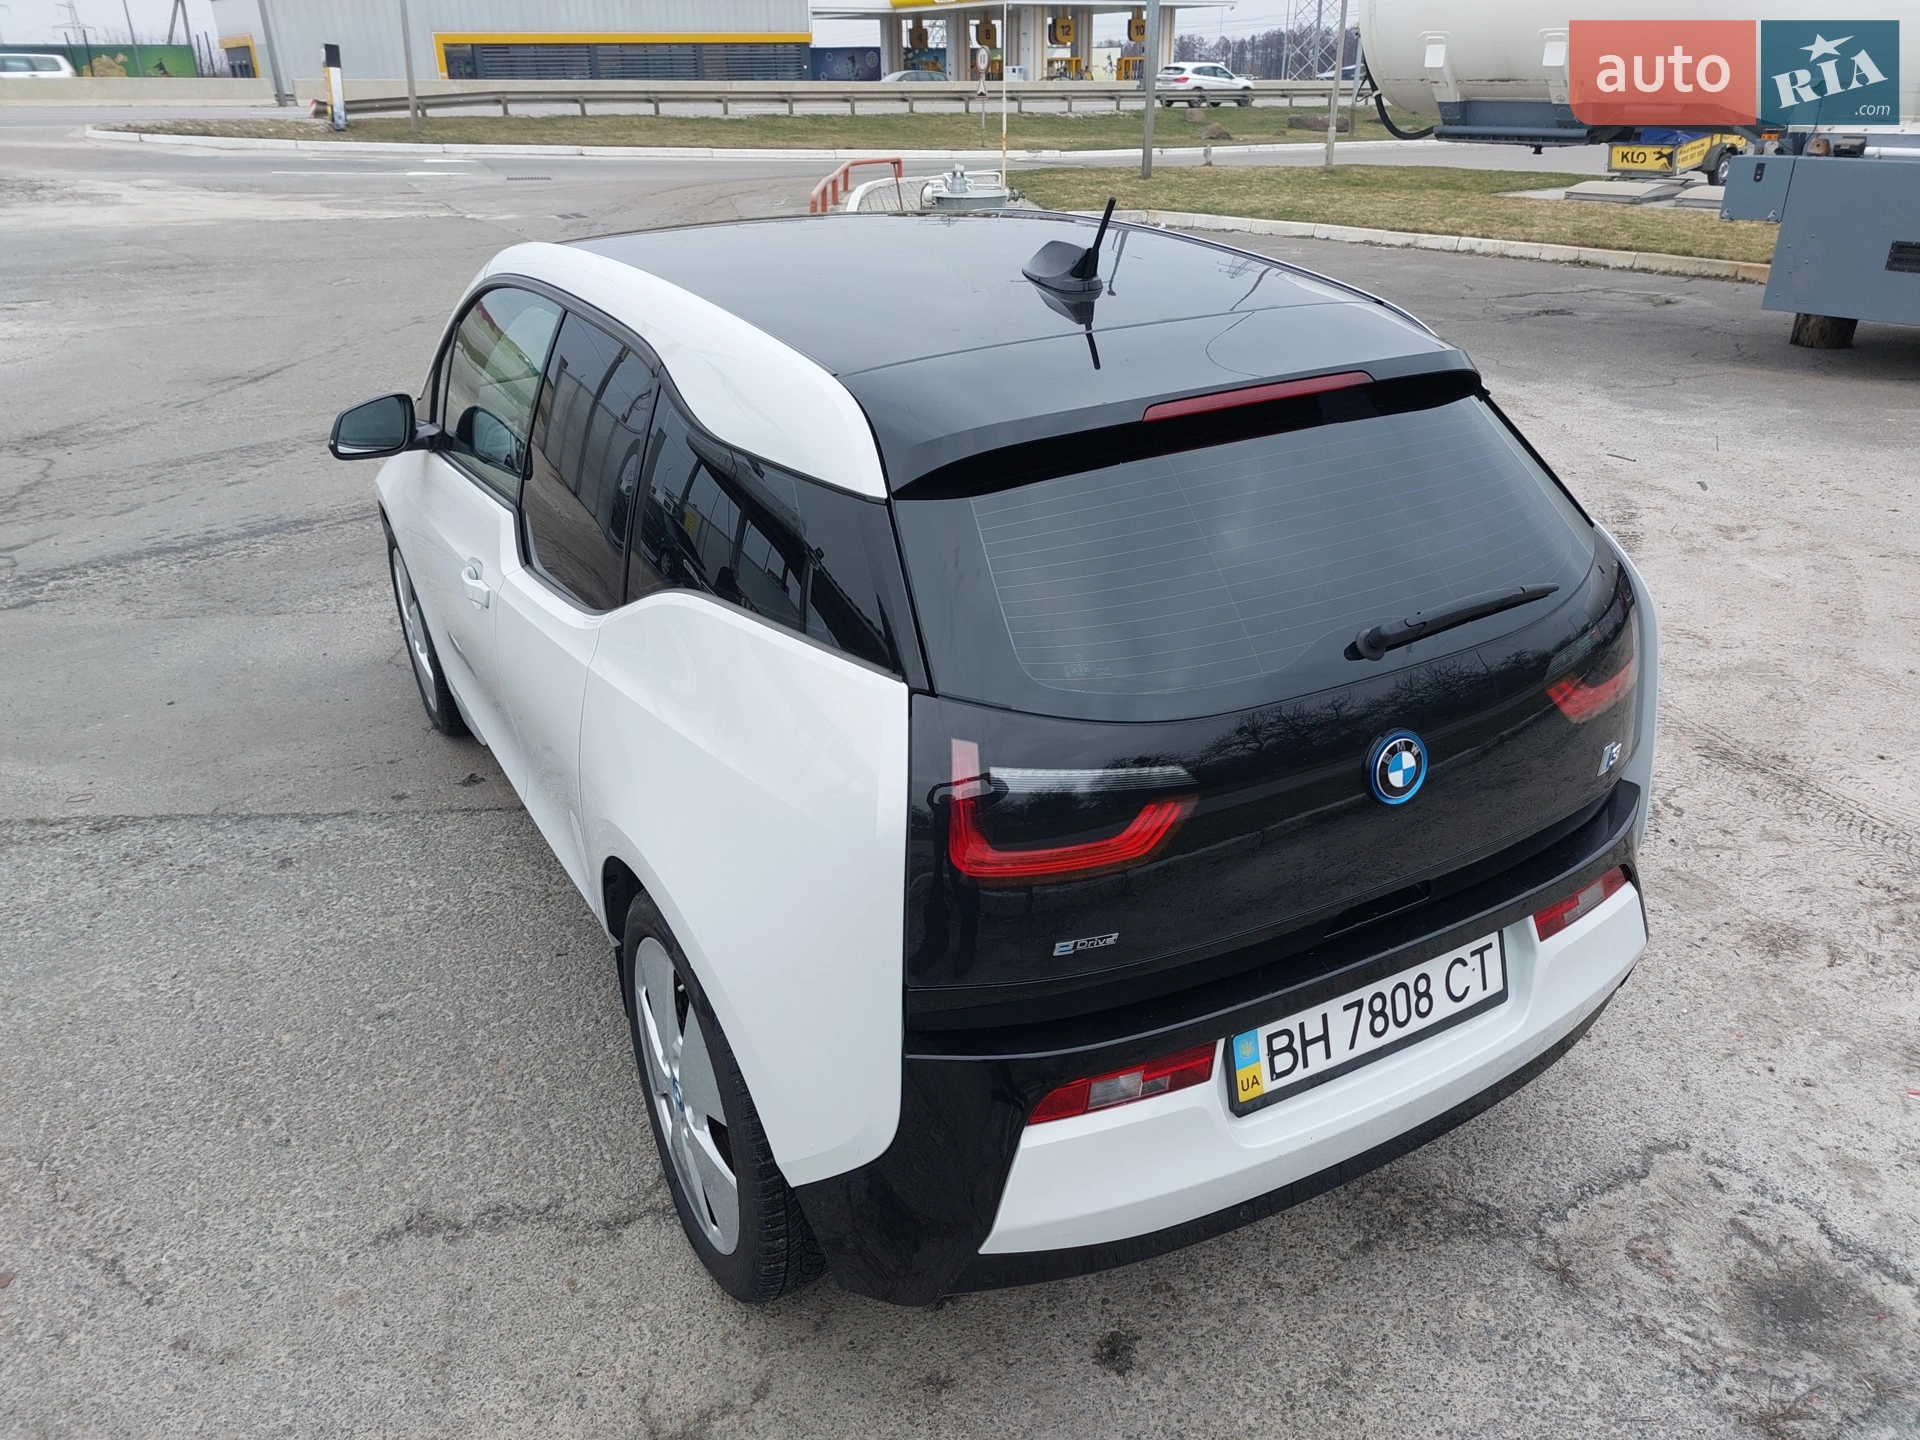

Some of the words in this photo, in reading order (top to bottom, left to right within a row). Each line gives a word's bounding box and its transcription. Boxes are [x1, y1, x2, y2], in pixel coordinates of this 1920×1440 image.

[1061, 24, 1072, 36] 12
[1135, 25, 1146, 36] 10
[1621, 151, 1647, 164] KLO
[1382, 741, 1421, 765] BMW
[1266, 1012, 1332, 1082] BH
[1342, 972, 1434, 1051] 7808
[1444, 942, 1493, 1003] CT
[1240, 1074, 1260, 1092] UA
